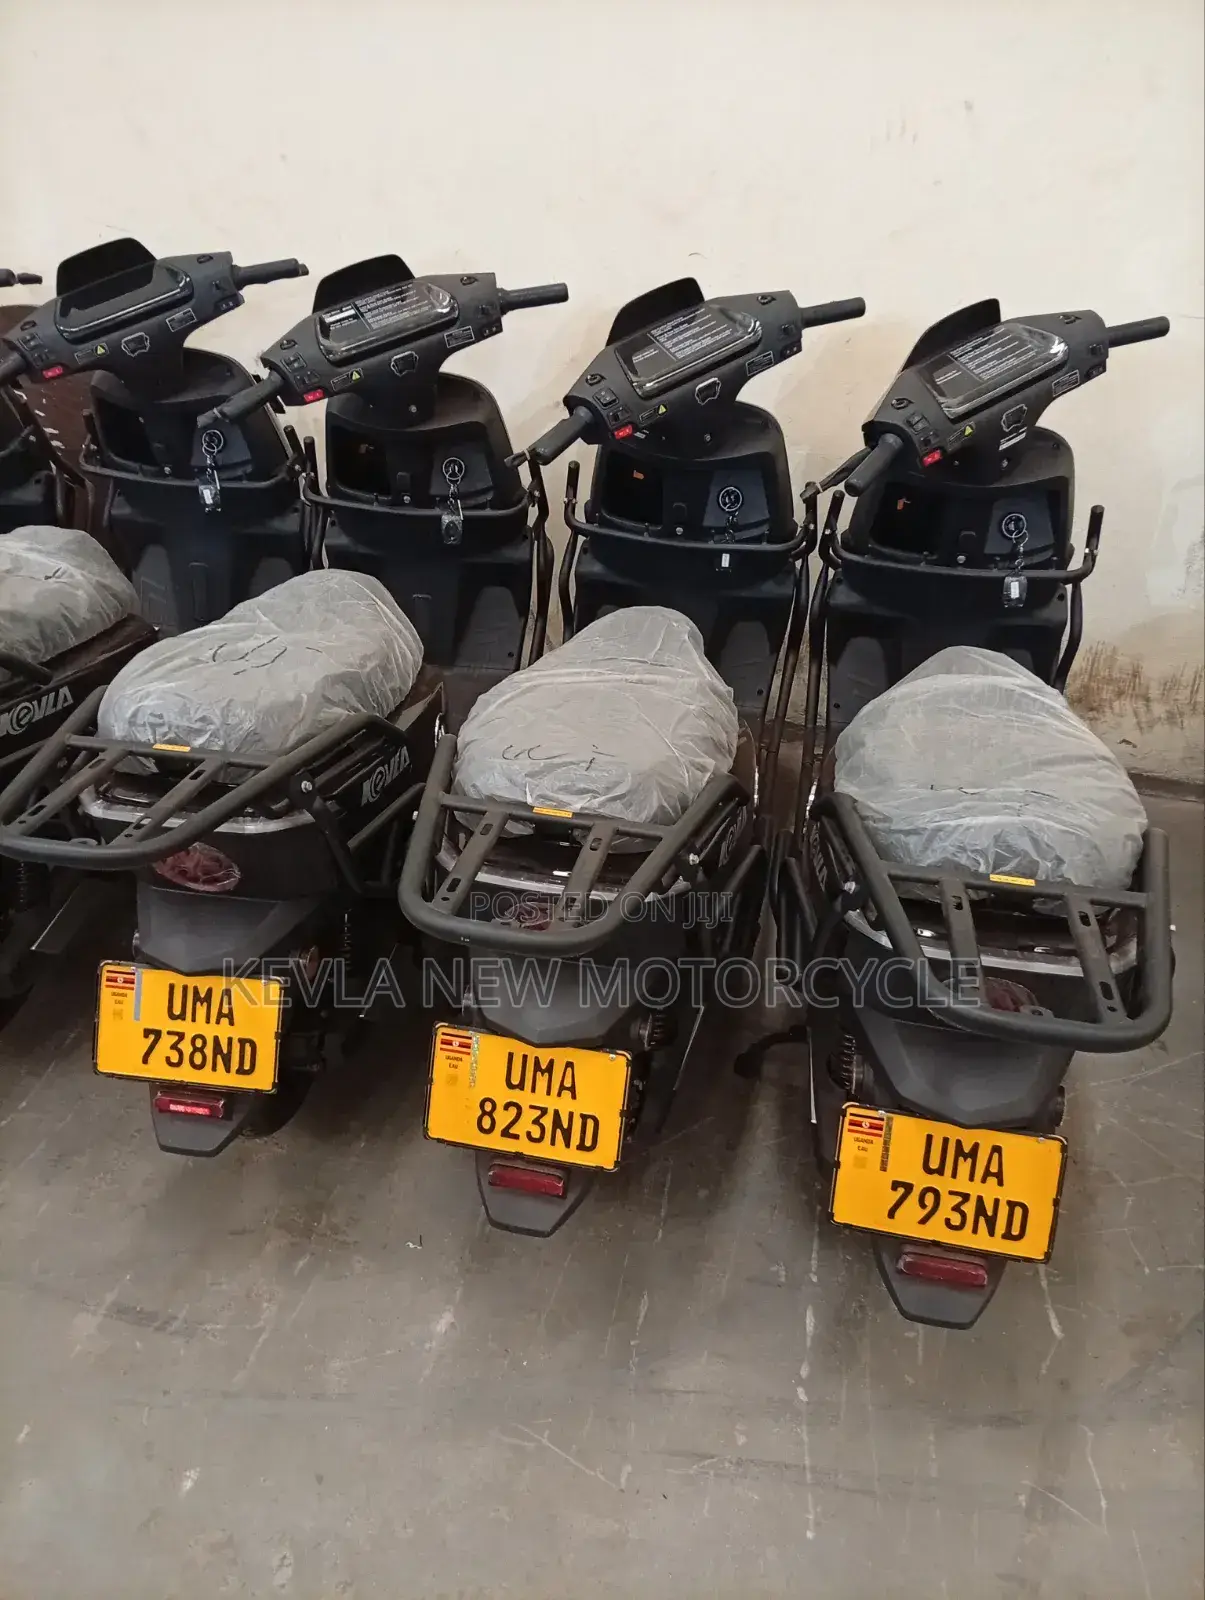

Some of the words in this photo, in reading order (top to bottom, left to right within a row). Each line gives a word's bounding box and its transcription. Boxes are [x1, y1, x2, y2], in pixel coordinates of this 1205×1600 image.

[167, 982, 235, 1027] UMA
[141, 1028, 257, 1075] 738ND
[504, 1052, 577, 1100] UMA
[476, 1097, 600, 1152] 823ND
[921, 1133, 1004, 1187] UMA
[886, 1180, 1029, 1242] 793ND
